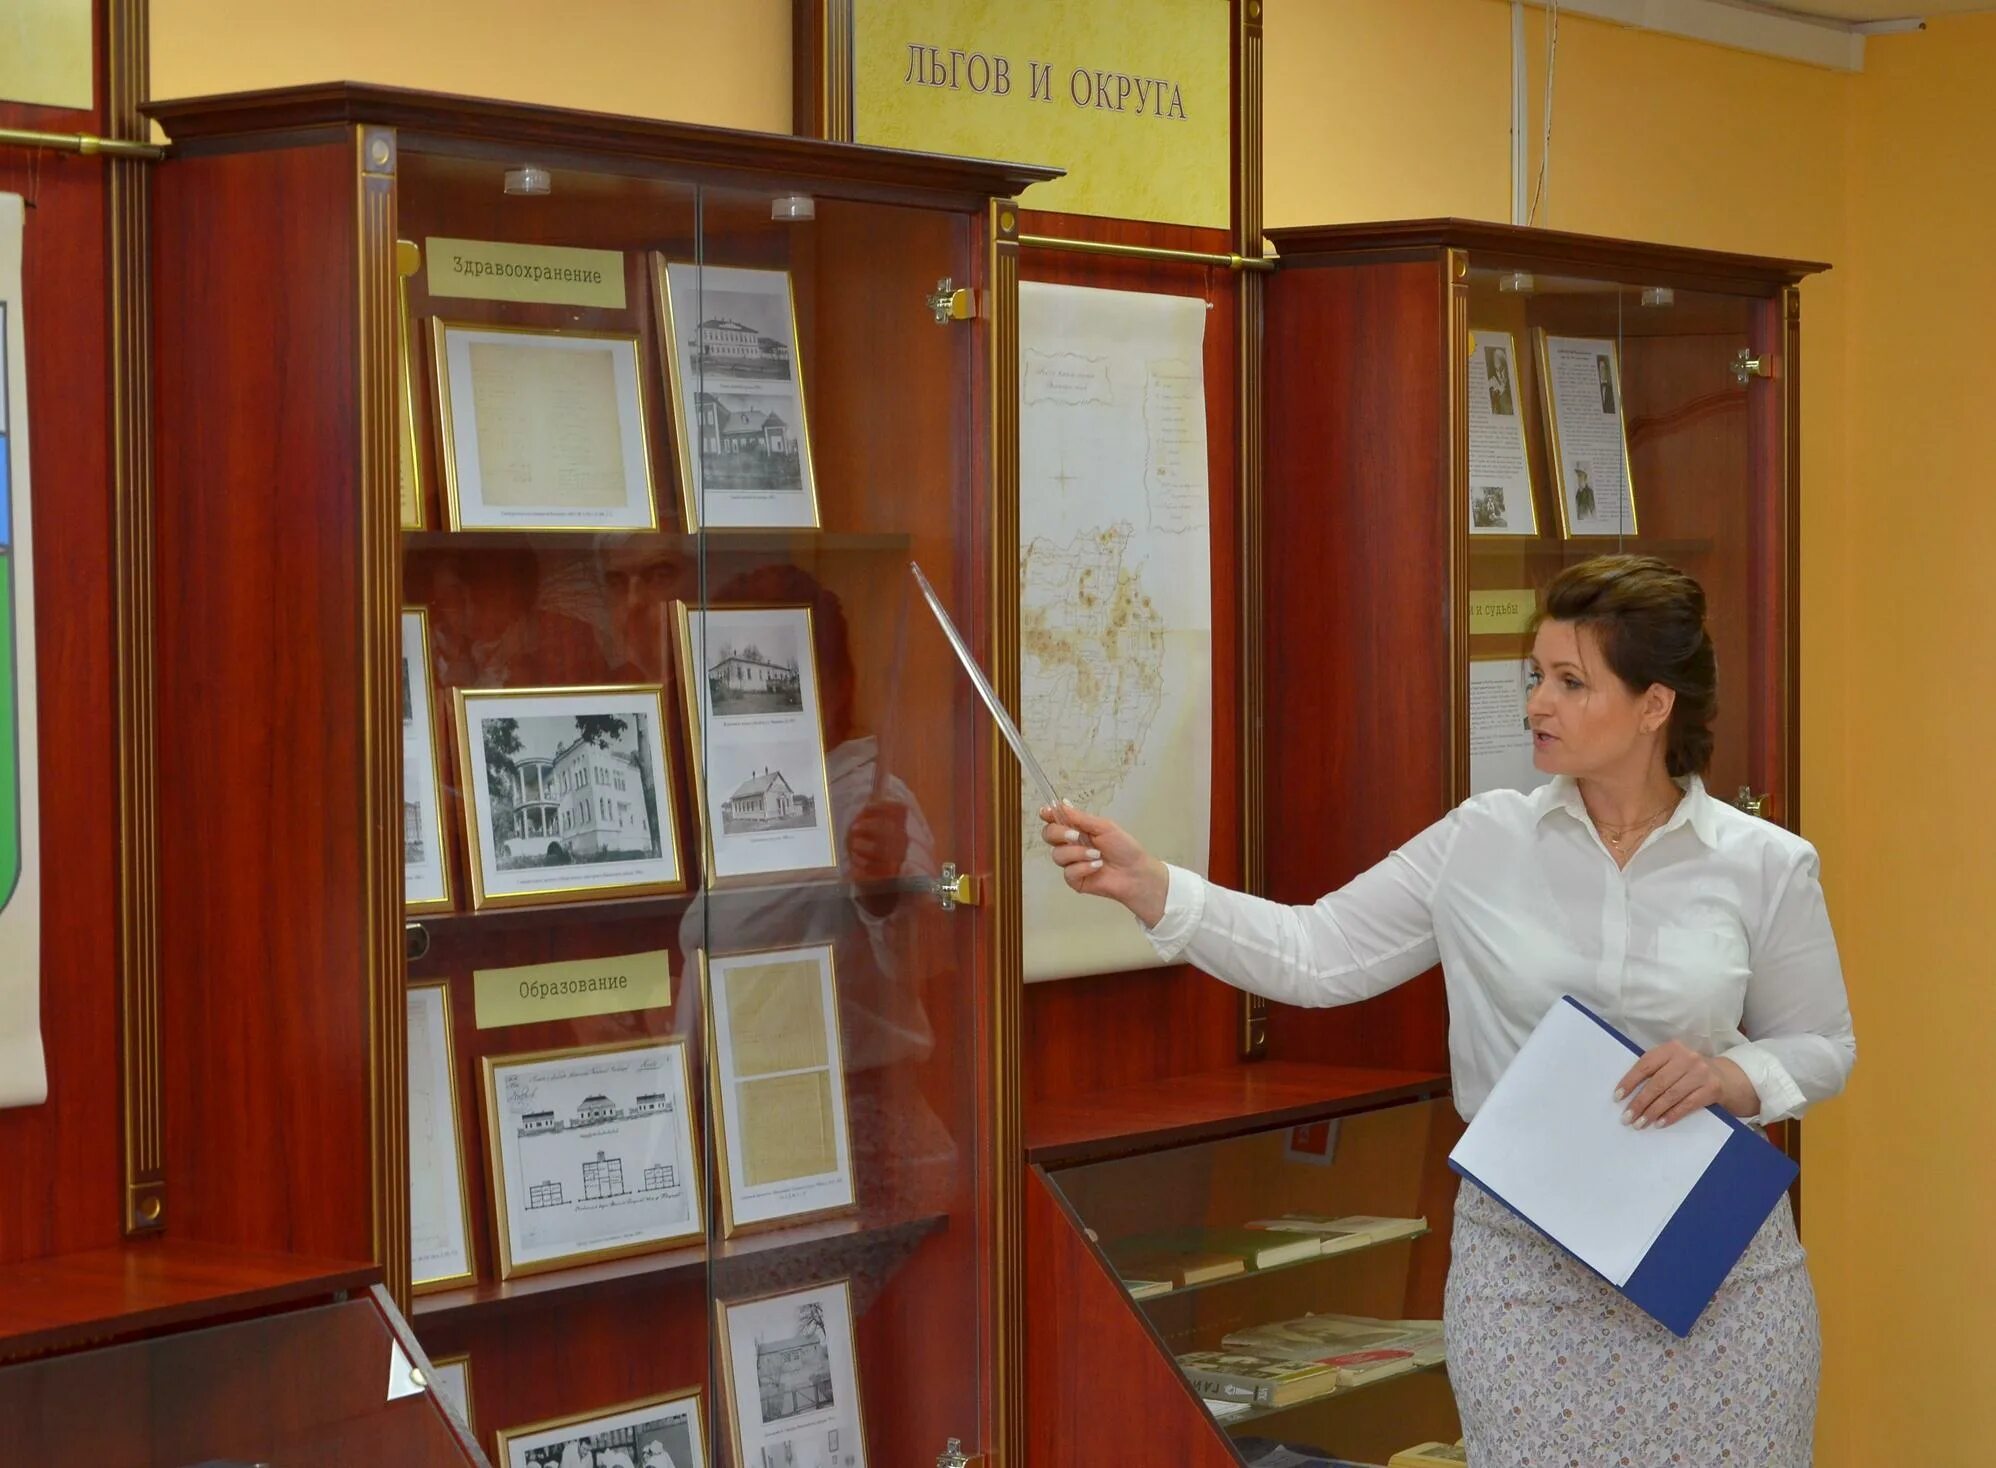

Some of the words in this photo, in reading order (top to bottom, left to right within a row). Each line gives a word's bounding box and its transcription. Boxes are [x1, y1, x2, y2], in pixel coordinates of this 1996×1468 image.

[905, 43, 1011, 95] ЛЬГОВ
[1029, 61, 1053, 101] И
[1070, 68, 1187, 120] ОКРУГА
[453, 255, 602, 284] Здравоохранение
[1485, 602, 1519, 617] судьбы
[519, 975, 628, 1000] Образование
